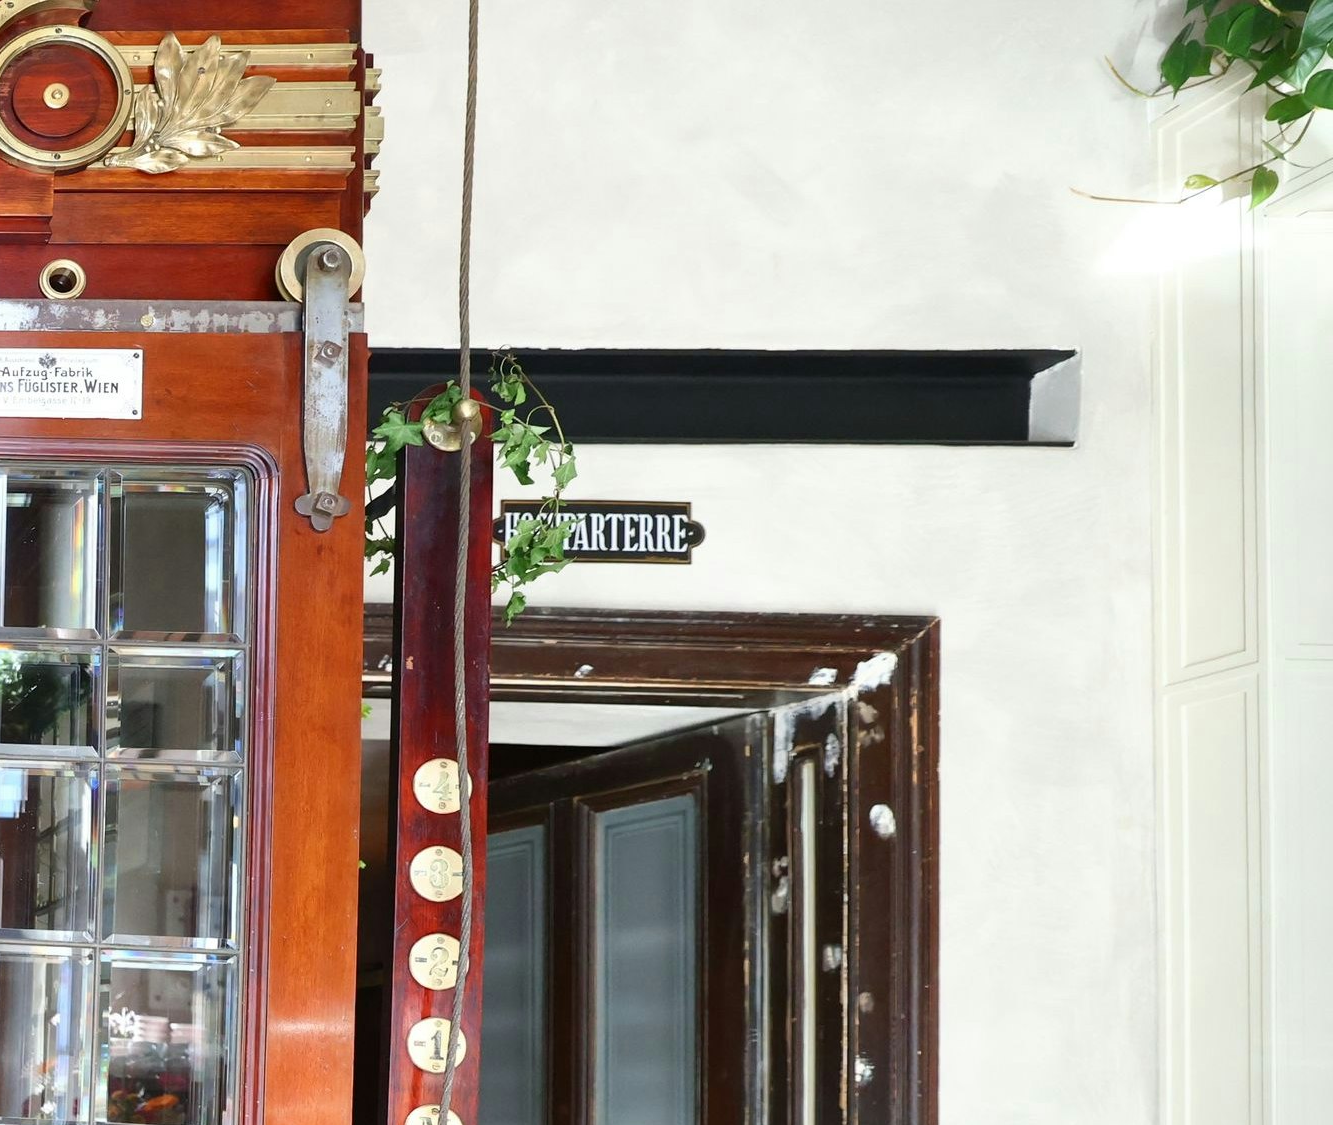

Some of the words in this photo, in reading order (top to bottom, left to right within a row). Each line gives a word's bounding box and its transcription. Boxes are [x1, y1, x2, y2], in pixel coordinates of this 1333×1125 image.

[0, 366, 94, 381] Aufzug-Fabrik
[84, 379, 119, 394] WIEN
[504, 512, 689, 552] HPARTERRE
[432, 771, 453, 801] 4
[429, 858, 449, 889] 3
[429, 946, 450, 978] 2
[430, 1030, 445, 1060] 1
